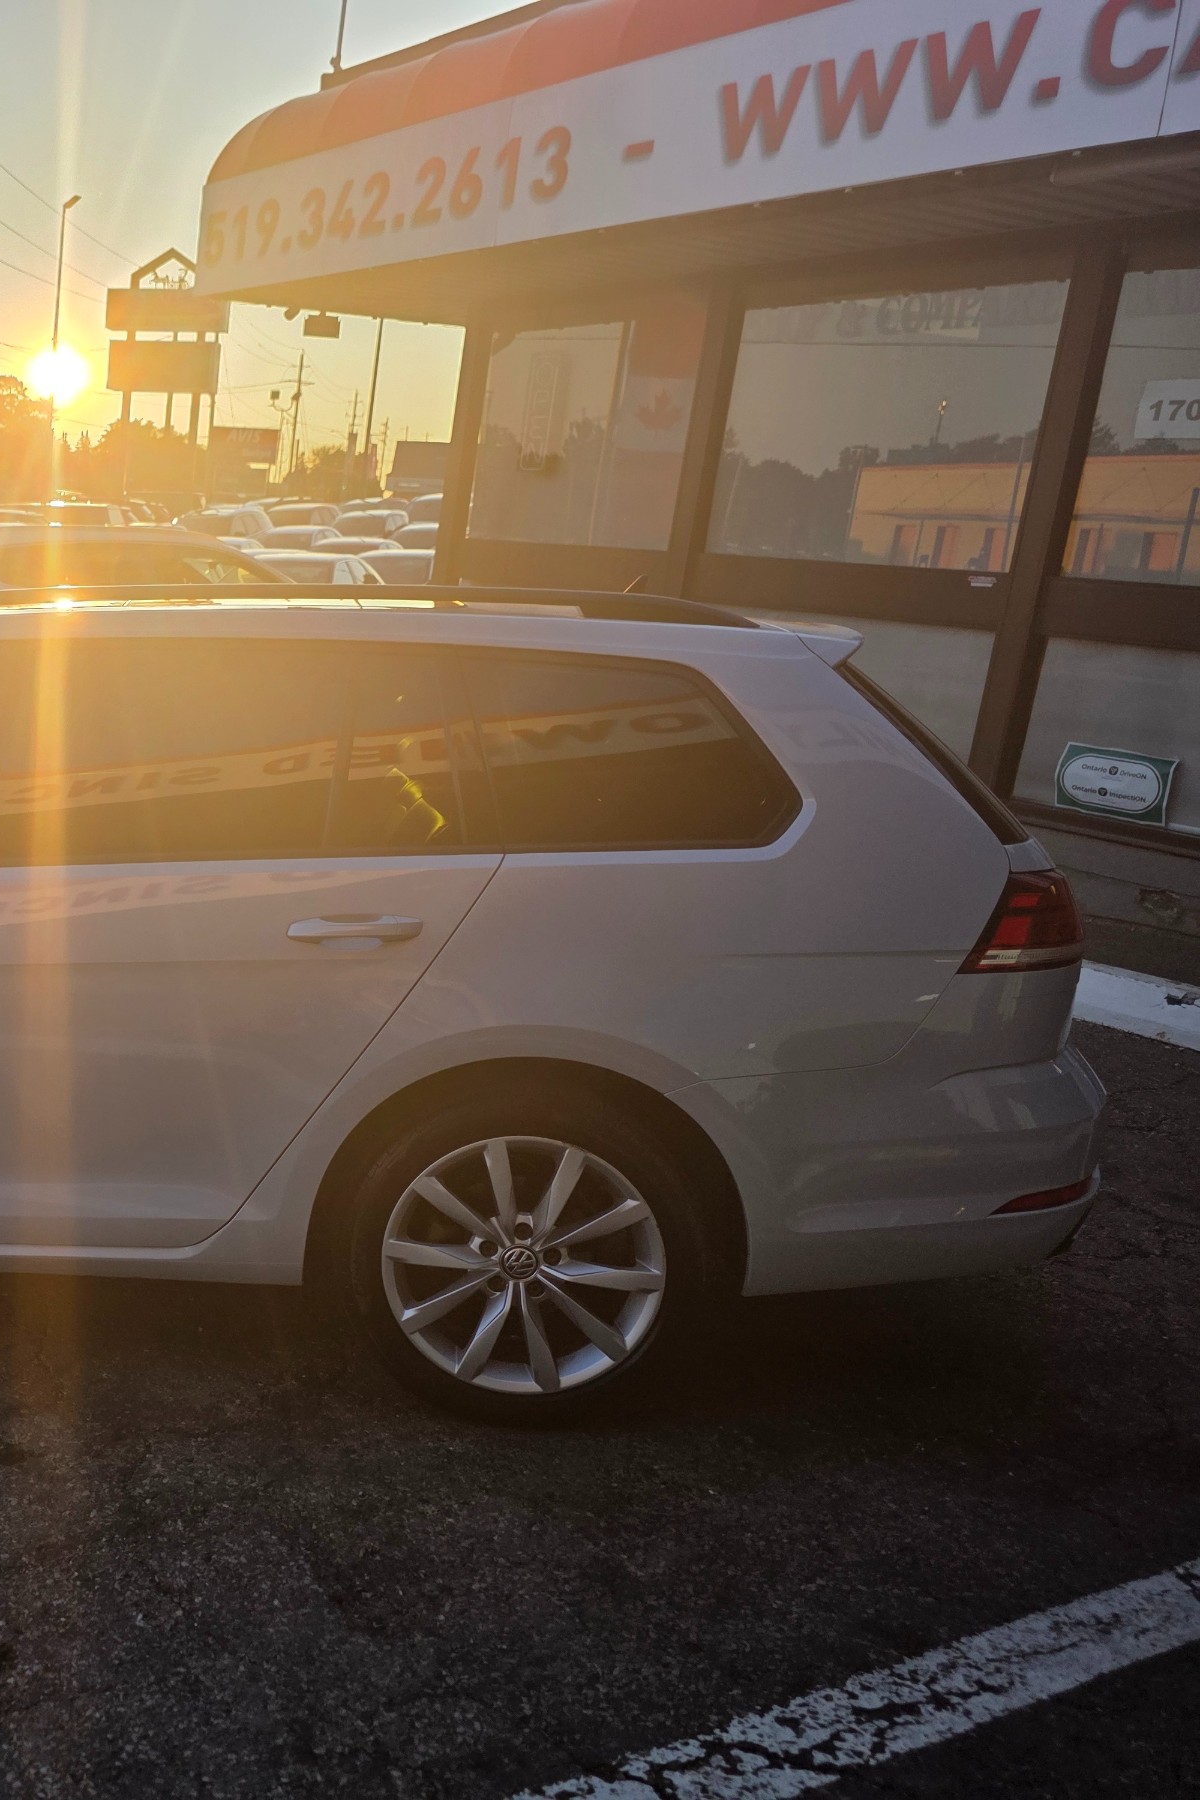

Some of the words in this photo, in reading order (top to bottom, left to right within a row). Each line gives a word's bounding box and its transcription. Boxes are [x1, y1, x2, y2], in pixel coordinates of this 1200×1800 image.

[204, 125, 571, 267] 519.342.2613
[719, 0, 1200, 162] WWW.C
[1081, 763, 1107, 774] Ontario
[1071, 784, 1097, 794] Ontario
